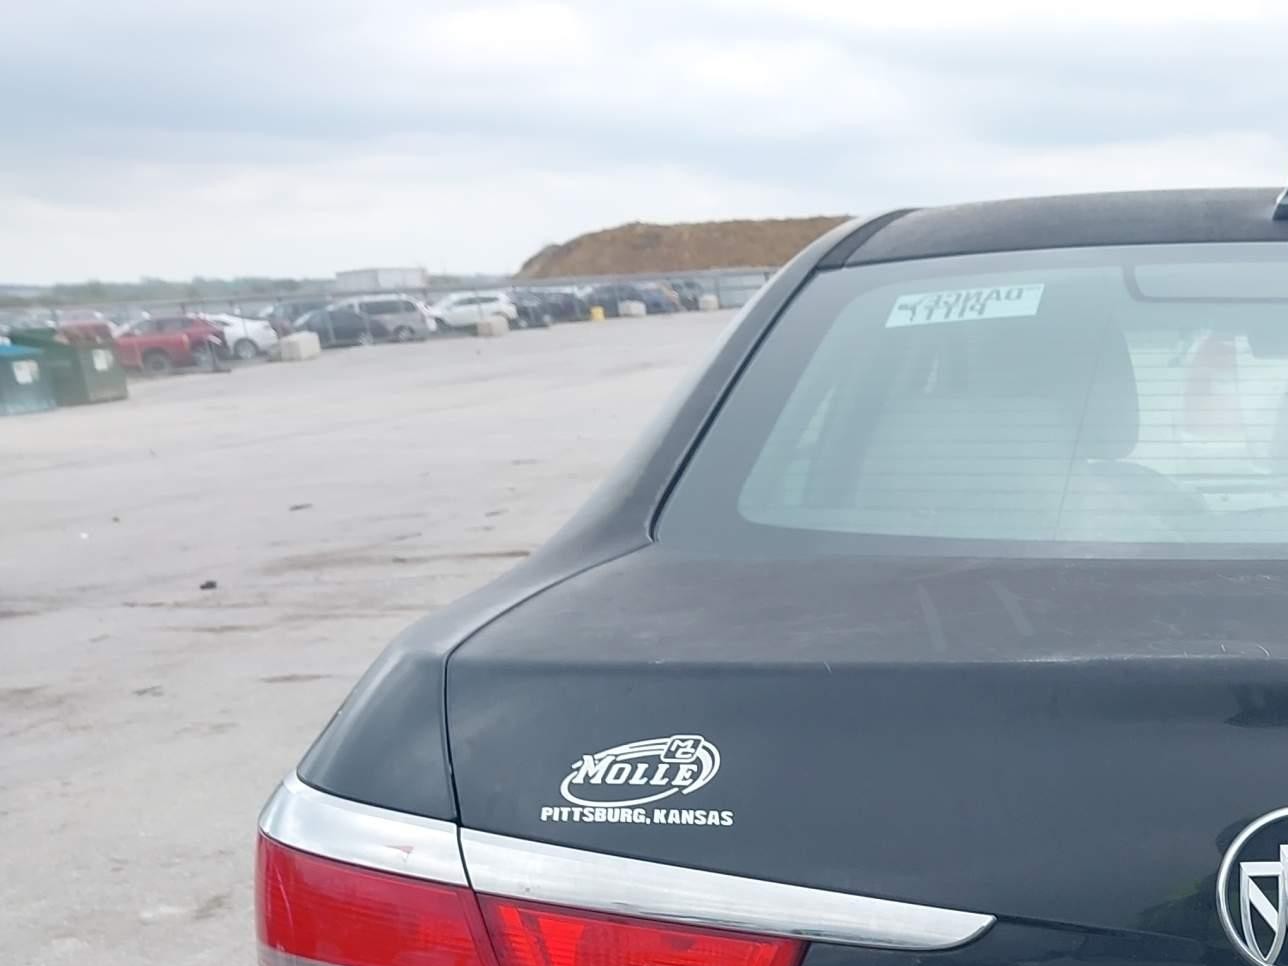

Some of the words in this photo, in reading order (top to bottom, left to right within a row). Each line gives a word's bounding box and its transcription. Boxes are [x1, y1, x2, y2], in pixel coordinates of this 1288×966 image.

[571, 754, 698, 786] MOLLE
[540, 806, 651, 825] PITTSBURG,
[653, 808, 734, 826] KANSAS
